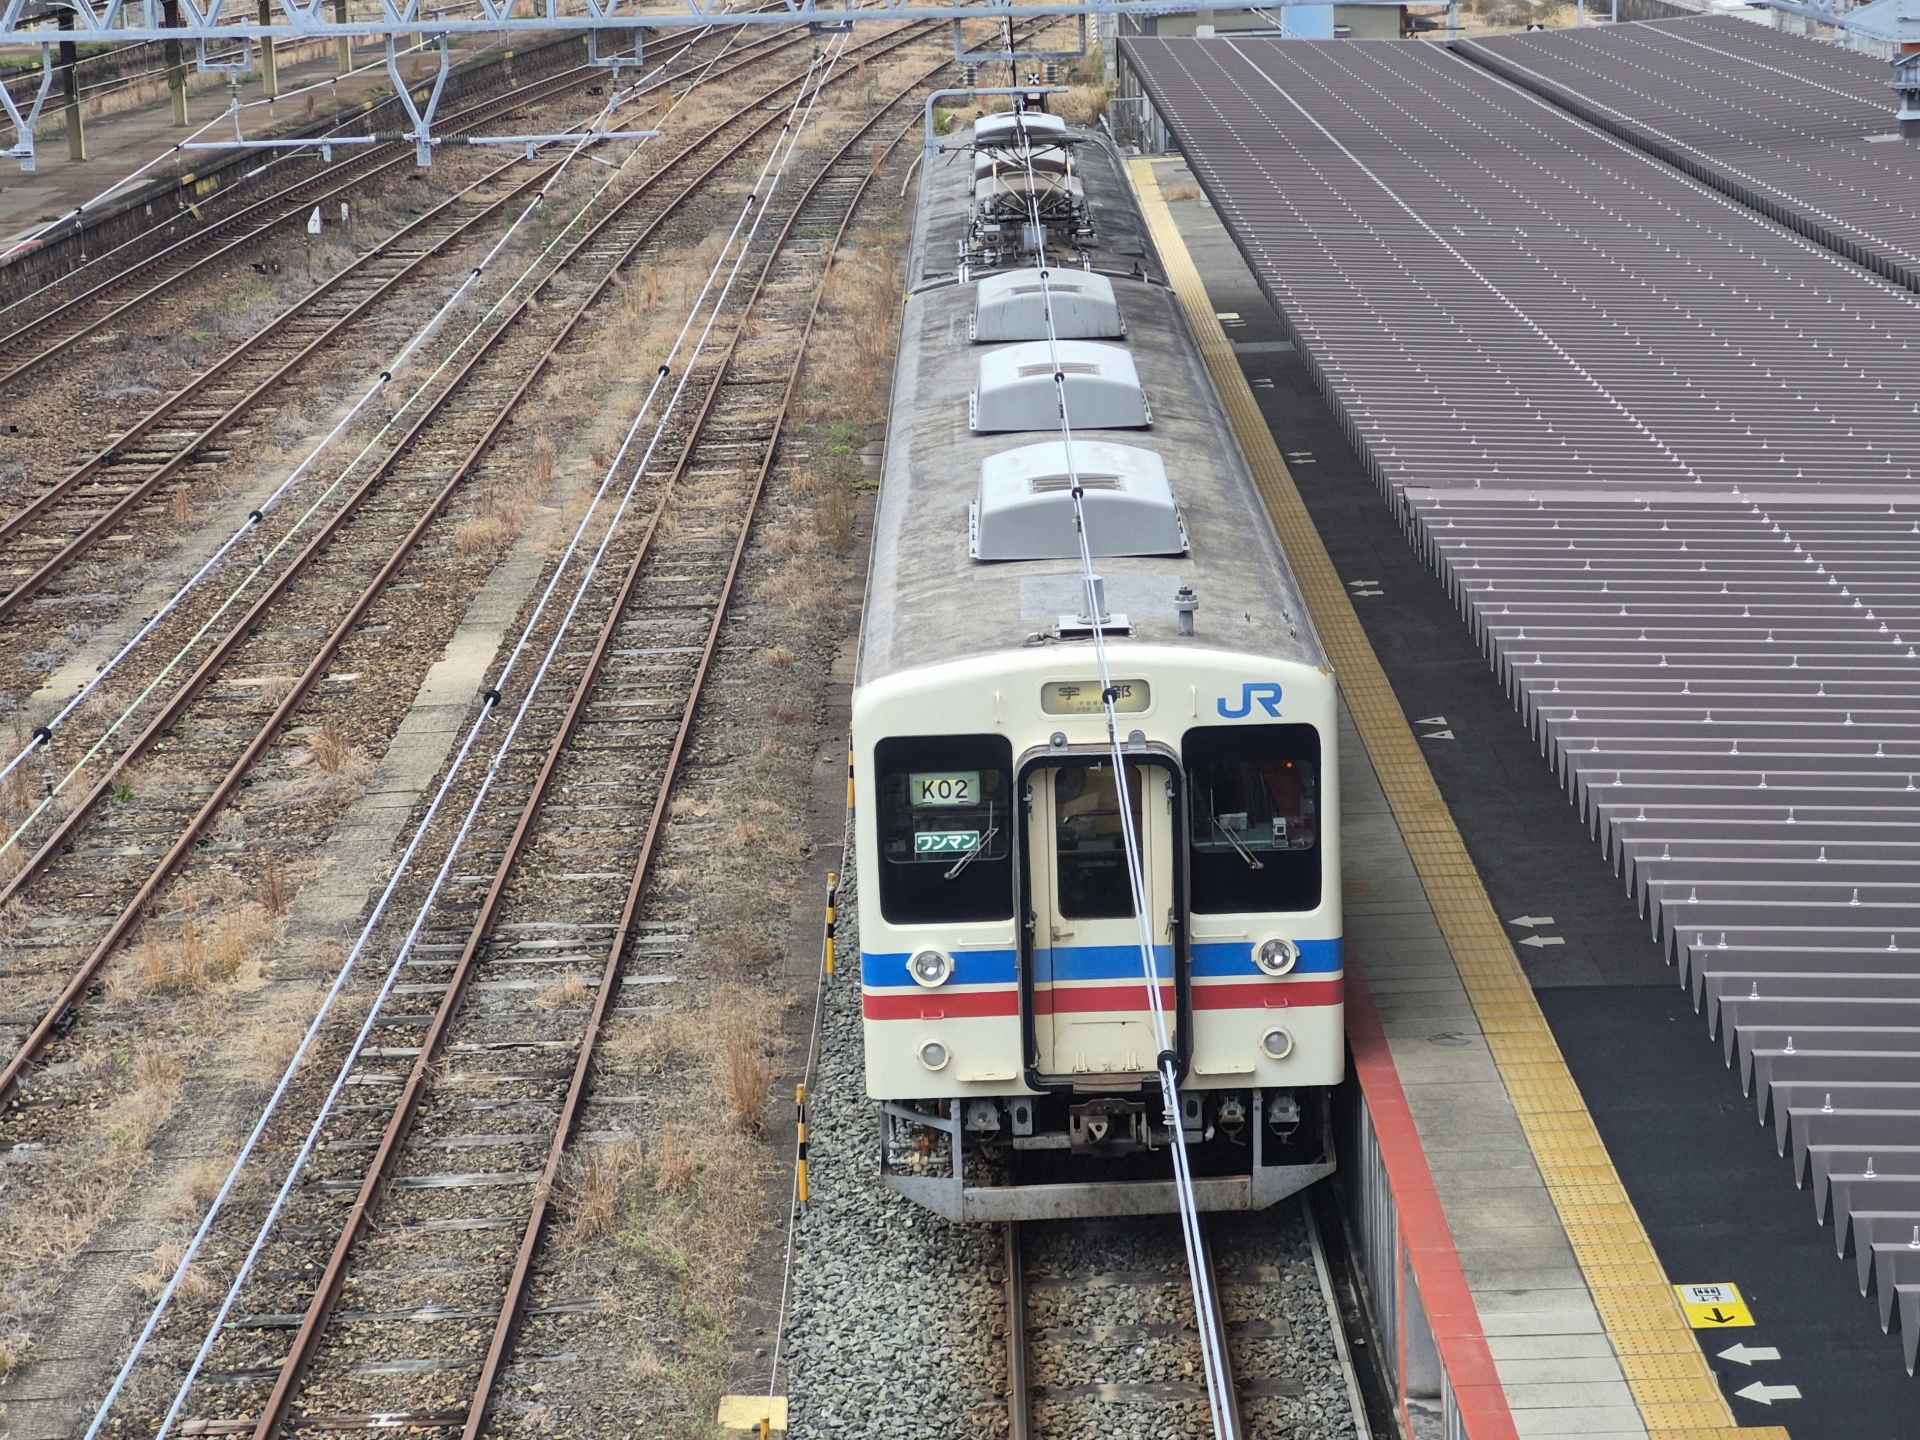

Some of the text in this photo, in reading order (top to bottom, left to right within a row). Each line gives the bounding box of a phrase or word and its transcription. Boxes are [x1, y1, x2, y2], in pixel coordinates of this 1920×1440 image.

[1217, 683, 1283, 718] JR
[922, 780, 968, 799] K02
[918, 834, 977, 851] ワンマン
